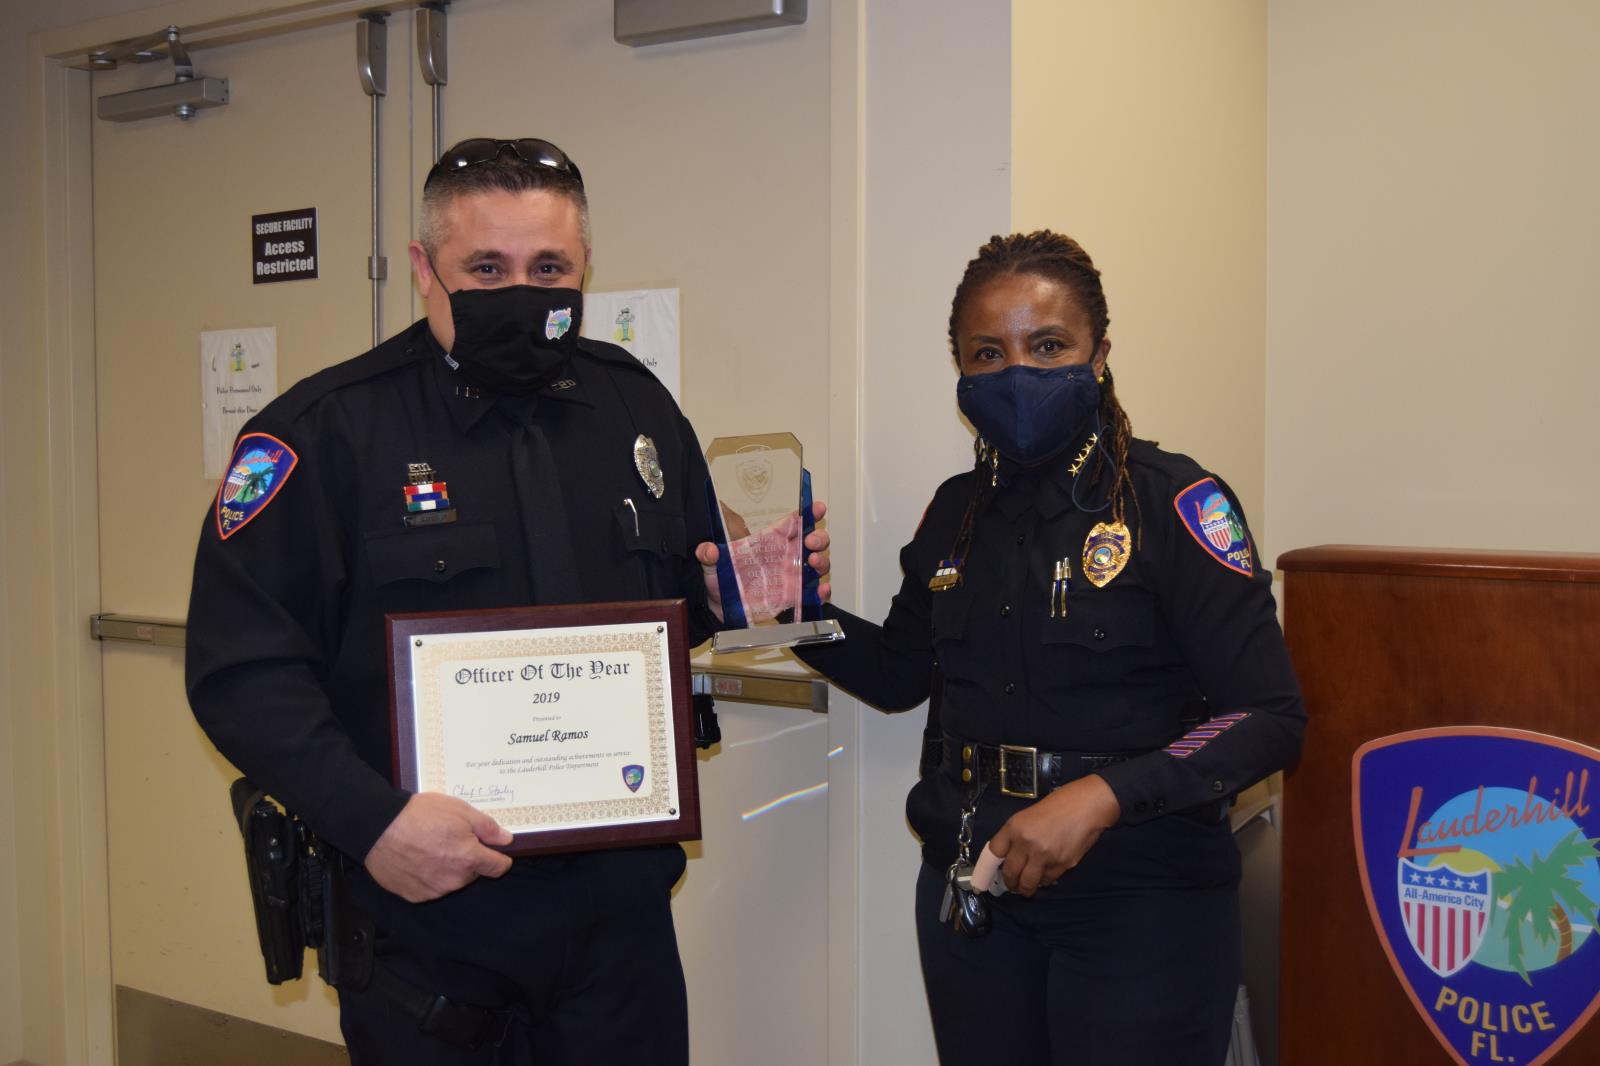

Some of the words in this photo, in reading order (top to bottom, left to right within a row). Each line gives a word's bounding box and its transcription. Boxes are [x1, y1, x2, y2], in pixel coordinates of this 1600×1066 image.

[256, 221, 282, 235] SECURE
[283, 218, 313, 232] FACILITY
[265, 240, 304, 256] Access
[256, 256, 314, 275] Restricted
[222, 506, 244, 520] POLICE
[455, 668, 514, 684] Officer
[520, 664, 544, 680] Of
[550, 662, 583, 680] The
[590, 660, 630, 680] Year
[532, 692, 560, 704] 2019
[508, 730, 550, 746] Samuel
[552, 728, 589, 742] Ramos
[492, 758, 522, 766] dedication
[534, 754, 568, 764] outstanding
[569, 752, 605, 760] achievements
[518, 764, 547, 774] Lauderhill
[548, 763, 566, 772] Police
[1398, 768, 1590, 857] Lauderhill
[1404, 887, 1462, 906] All-America
[1464, 894, 1485, 910] City
[1434, 986, 1556, 1034] POLICE
[1471, 1031, 1516, 1062] FL.
